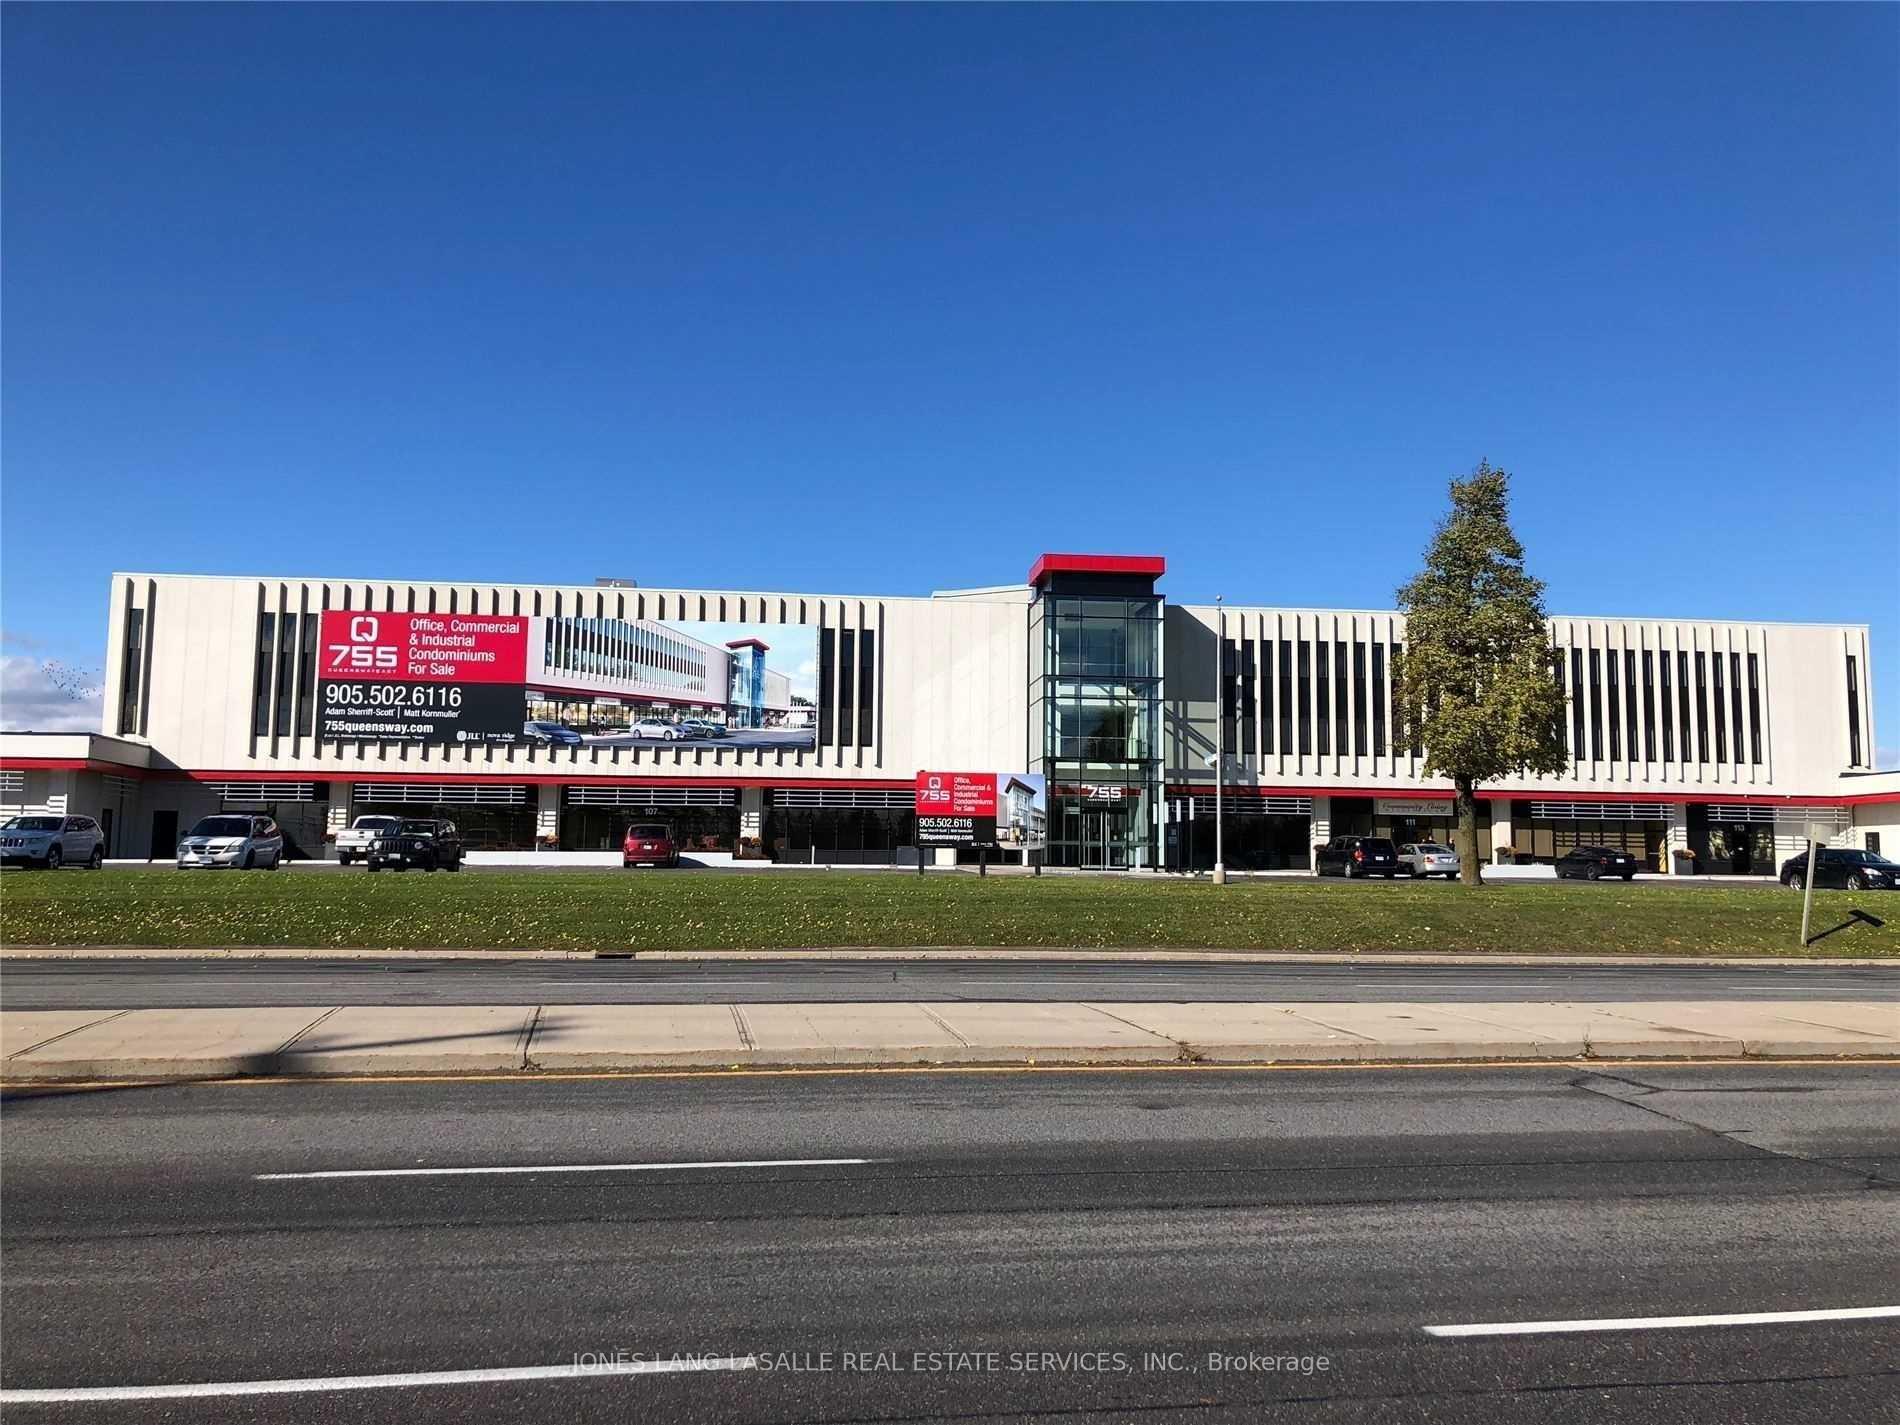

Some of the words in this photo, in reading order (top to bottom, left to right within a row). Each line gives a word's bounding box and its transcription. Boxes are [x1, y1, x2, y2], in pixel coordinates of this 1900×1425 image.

[351, 616, 379, 642] Q
[410, 619, 447, 633] Office,
[450, 619, 520, 634] Commercial
[409, 634, 418, 645] &
[422, 634, 475, 647] Industrial
[328, 645, 398, 667] 755
[408, 648, 496, 662] Condominiums
[408, 662, 426, 674] For
[430, 663, 456, 676] Sale
[325, 684, 462, 707] 905.502.6116
[325, 707, 346, 716] Adam
[403, 709, 420, 718] Matt
[325, 720, 434, 734] 755queensway.com
[920, 790, 950, 801] 755
[1087, 786, 1121, 798] 755
[644, 807, 658, 815] 107
[919, 817, 973, 828] 905.502.6116
[1733, 824, 1745, 832] 113
